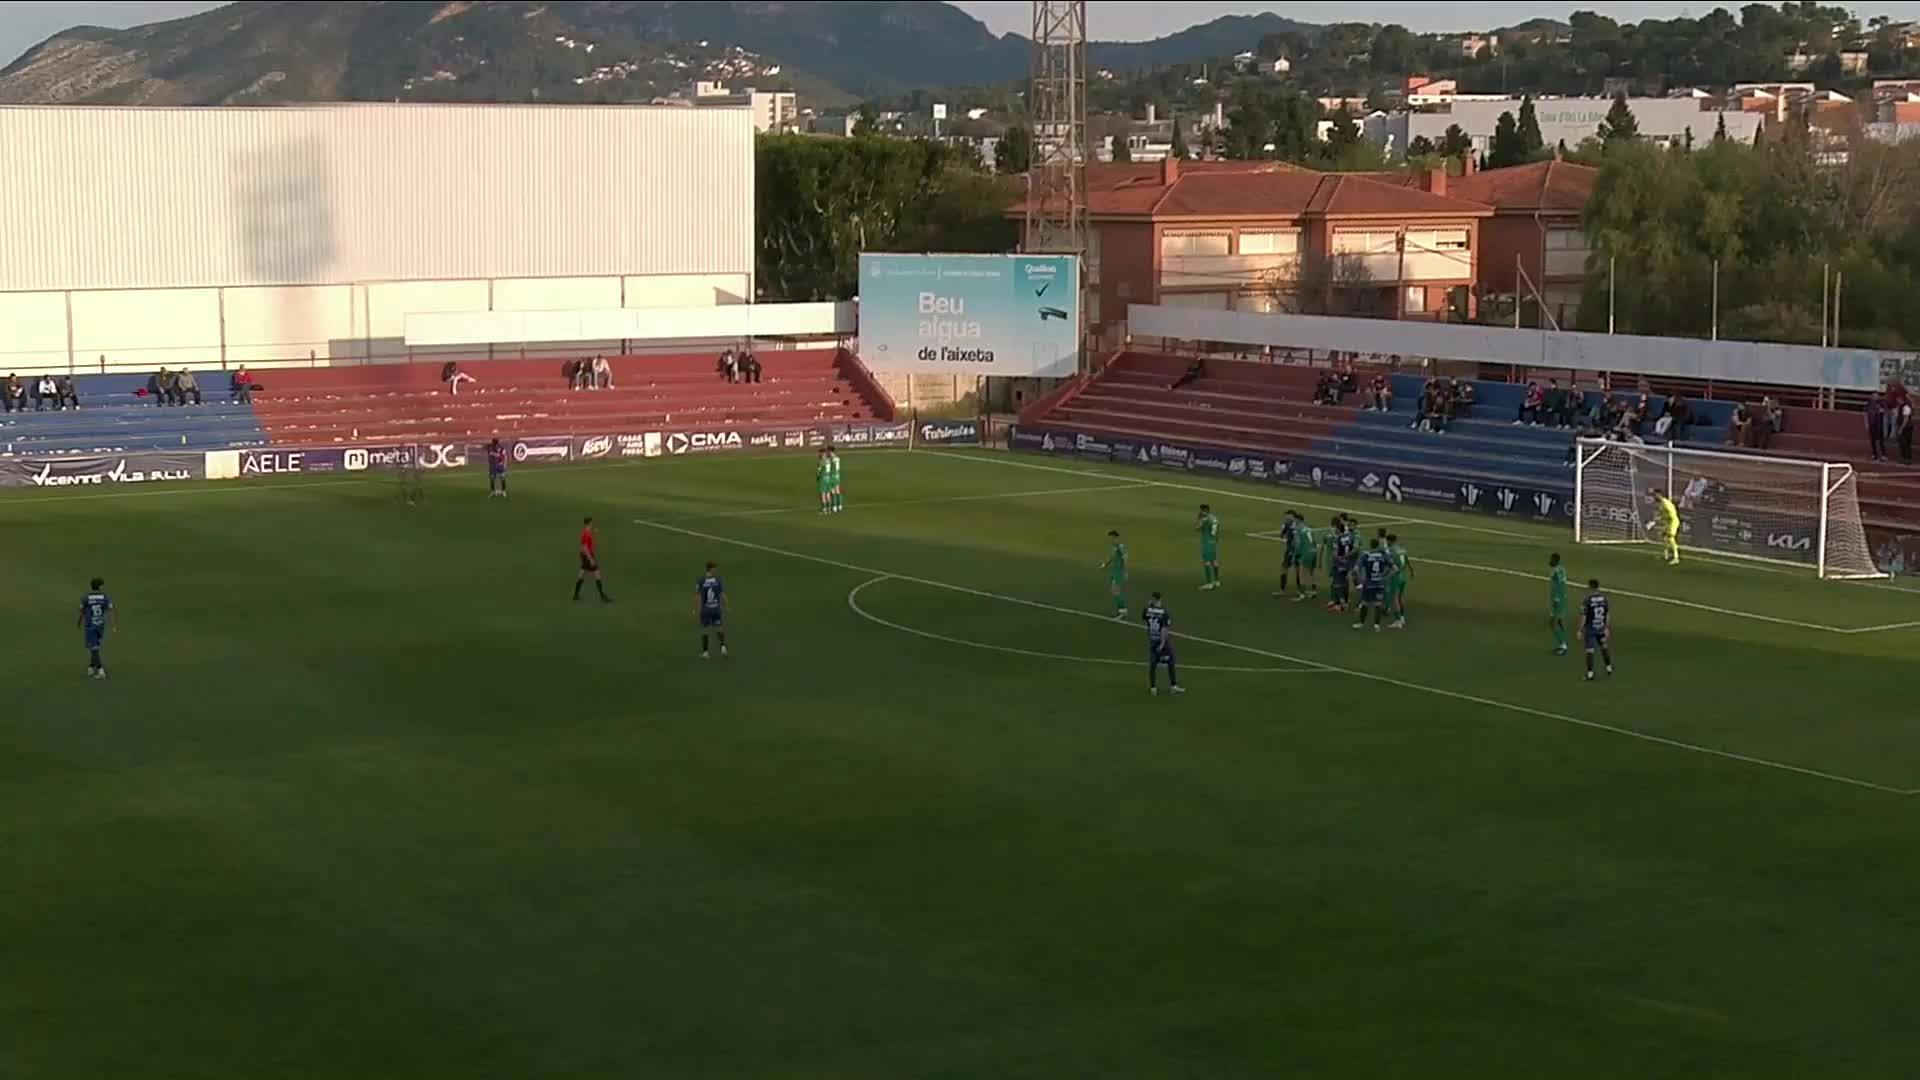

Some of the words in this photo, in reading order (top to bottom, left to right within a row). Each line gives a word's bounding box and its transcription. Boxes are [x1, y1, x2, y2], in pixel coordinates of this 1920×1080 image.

[919, 292, 964, 314] Beu
[919, 315, 981, 343] aigua
[918, 346, 936, 360] de
[941, 346, 994, 362] l'aixeta
[691, 432, 742, 446] CMA
[1767, 533, 1810, 549] KIA
